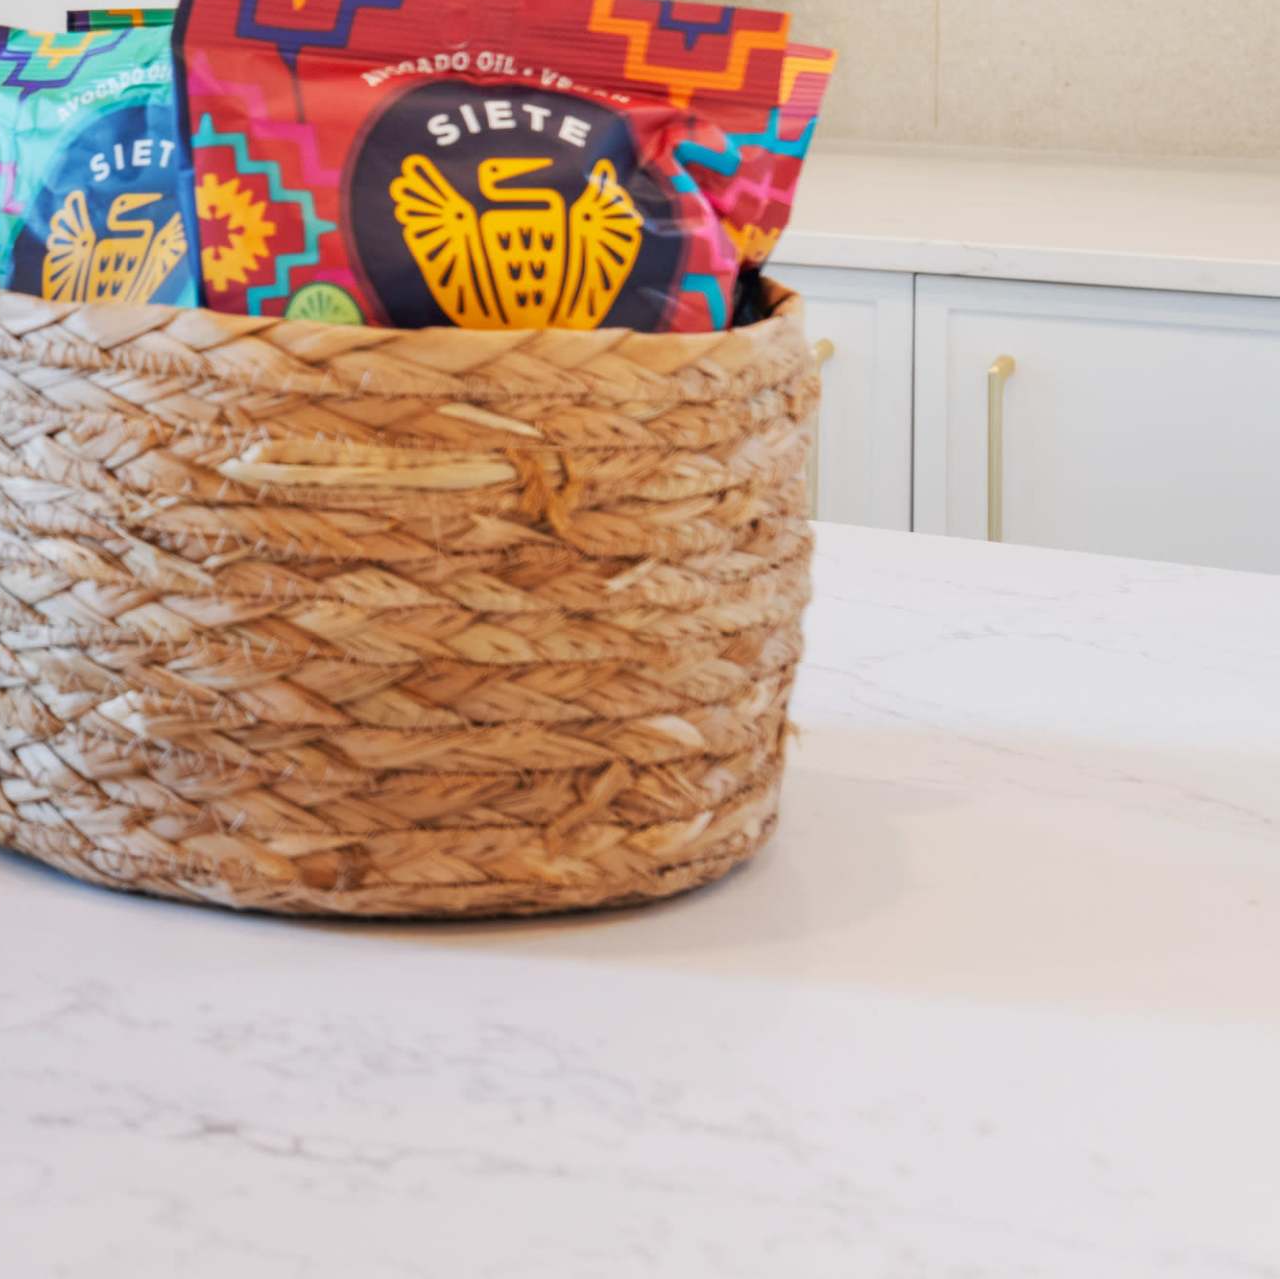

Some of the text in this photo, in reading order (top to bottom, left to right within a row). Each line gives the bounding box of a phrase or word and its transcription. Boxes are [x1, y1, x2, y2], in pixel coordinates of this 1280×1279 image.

[476, 51, 517, 76] OIL
[426, 100, 592, 148] SIETE
[89, 138, 176, 182] SIET
